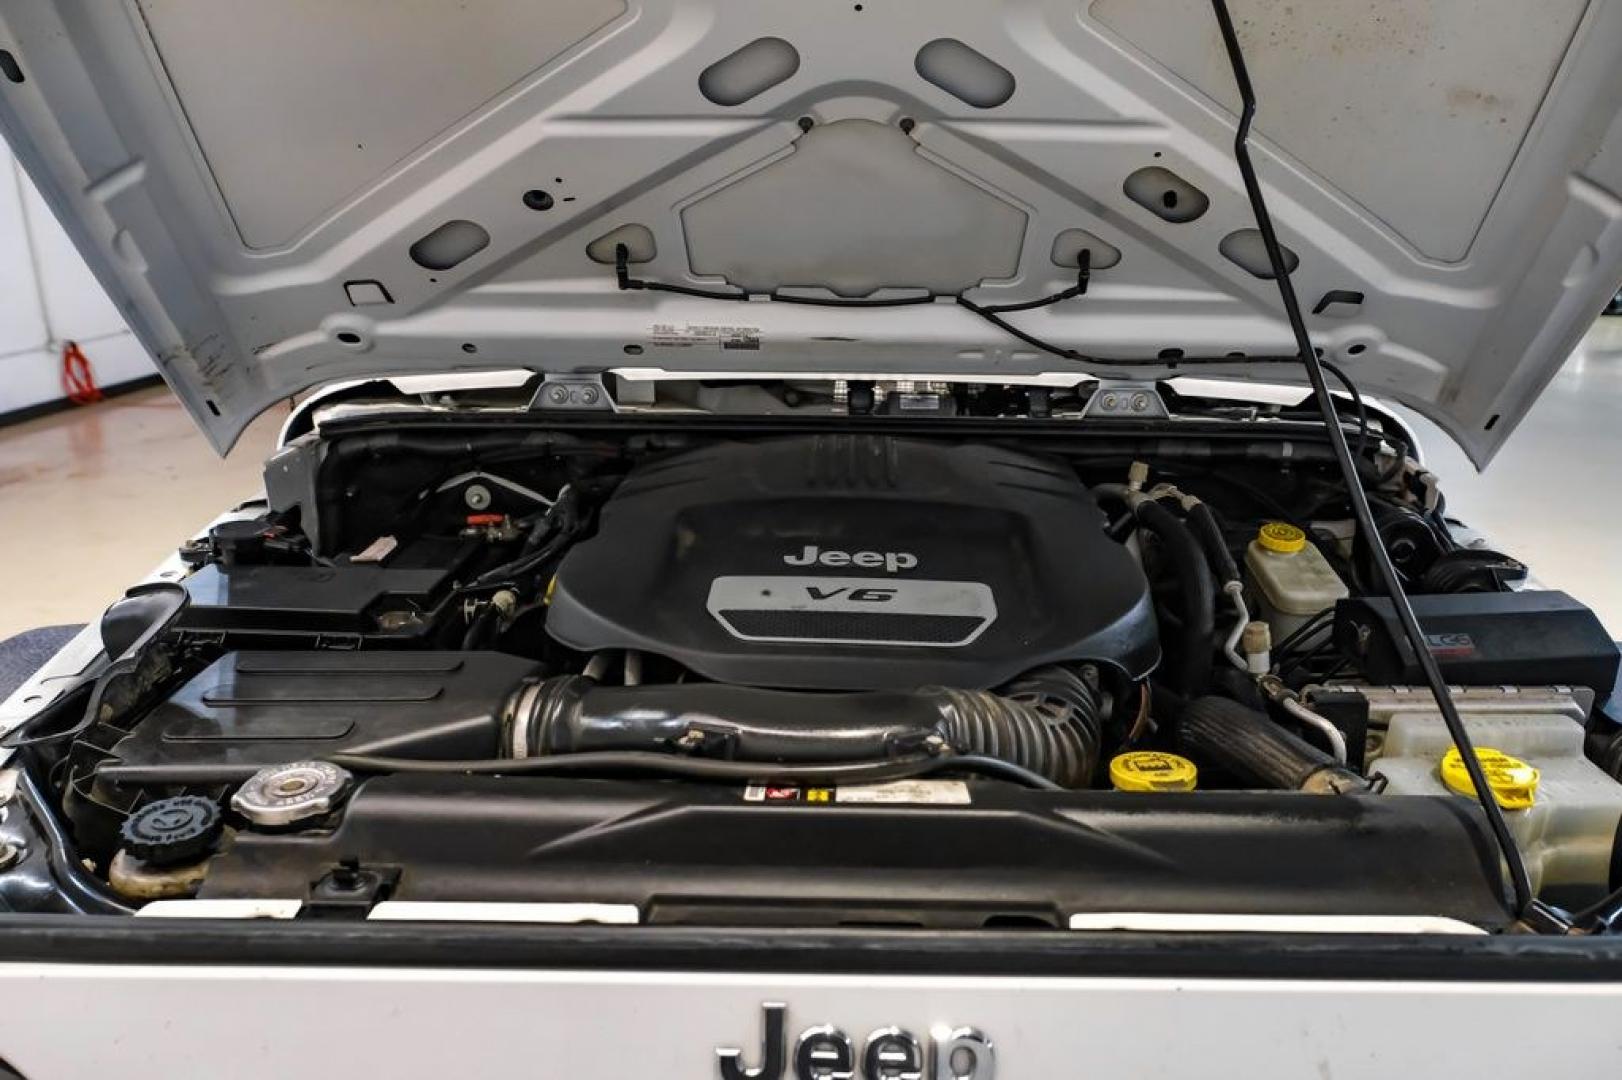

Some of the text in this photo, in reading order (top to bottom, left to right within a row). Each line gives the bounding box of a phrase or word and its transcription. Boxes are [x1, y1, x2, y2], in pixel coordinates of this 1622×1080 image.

[783, 545, 918, 573] Jeep
[805, 586, 898, 602] V6
[715, 1001, 997, 1080] Jeep
